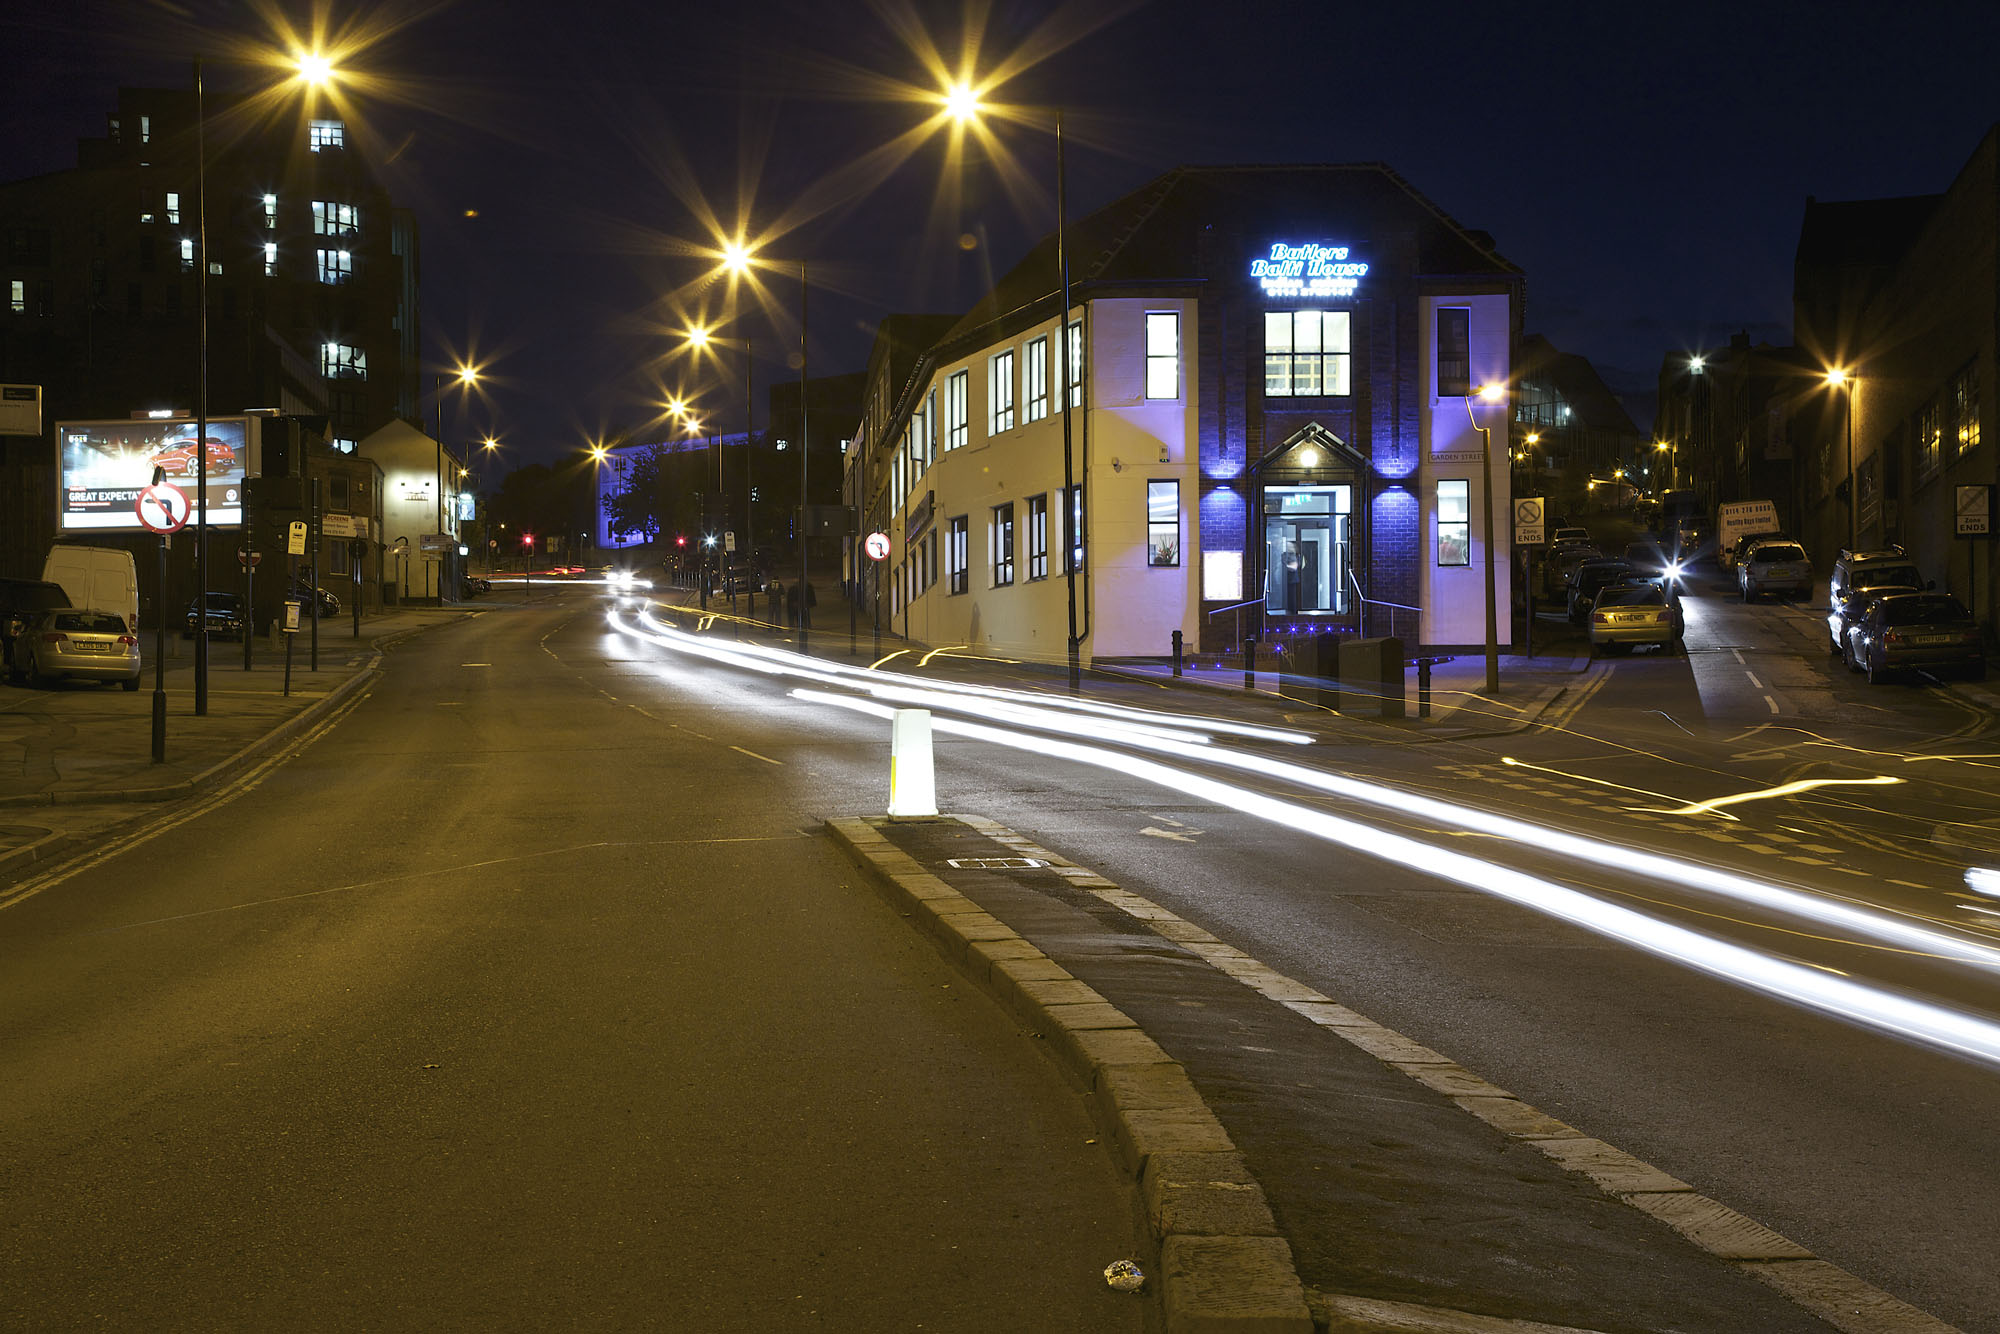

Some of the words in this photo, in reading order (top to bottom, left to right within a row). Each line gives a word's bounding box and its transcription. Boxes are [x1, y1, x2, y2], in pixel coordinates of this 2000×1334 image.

[1270, 243, 1349, 260] Butlers
[1250, 260, 1304, 277] Balti
[1306, 260, 1369, 276] House
[69, 491, 97, 501] GREAT
